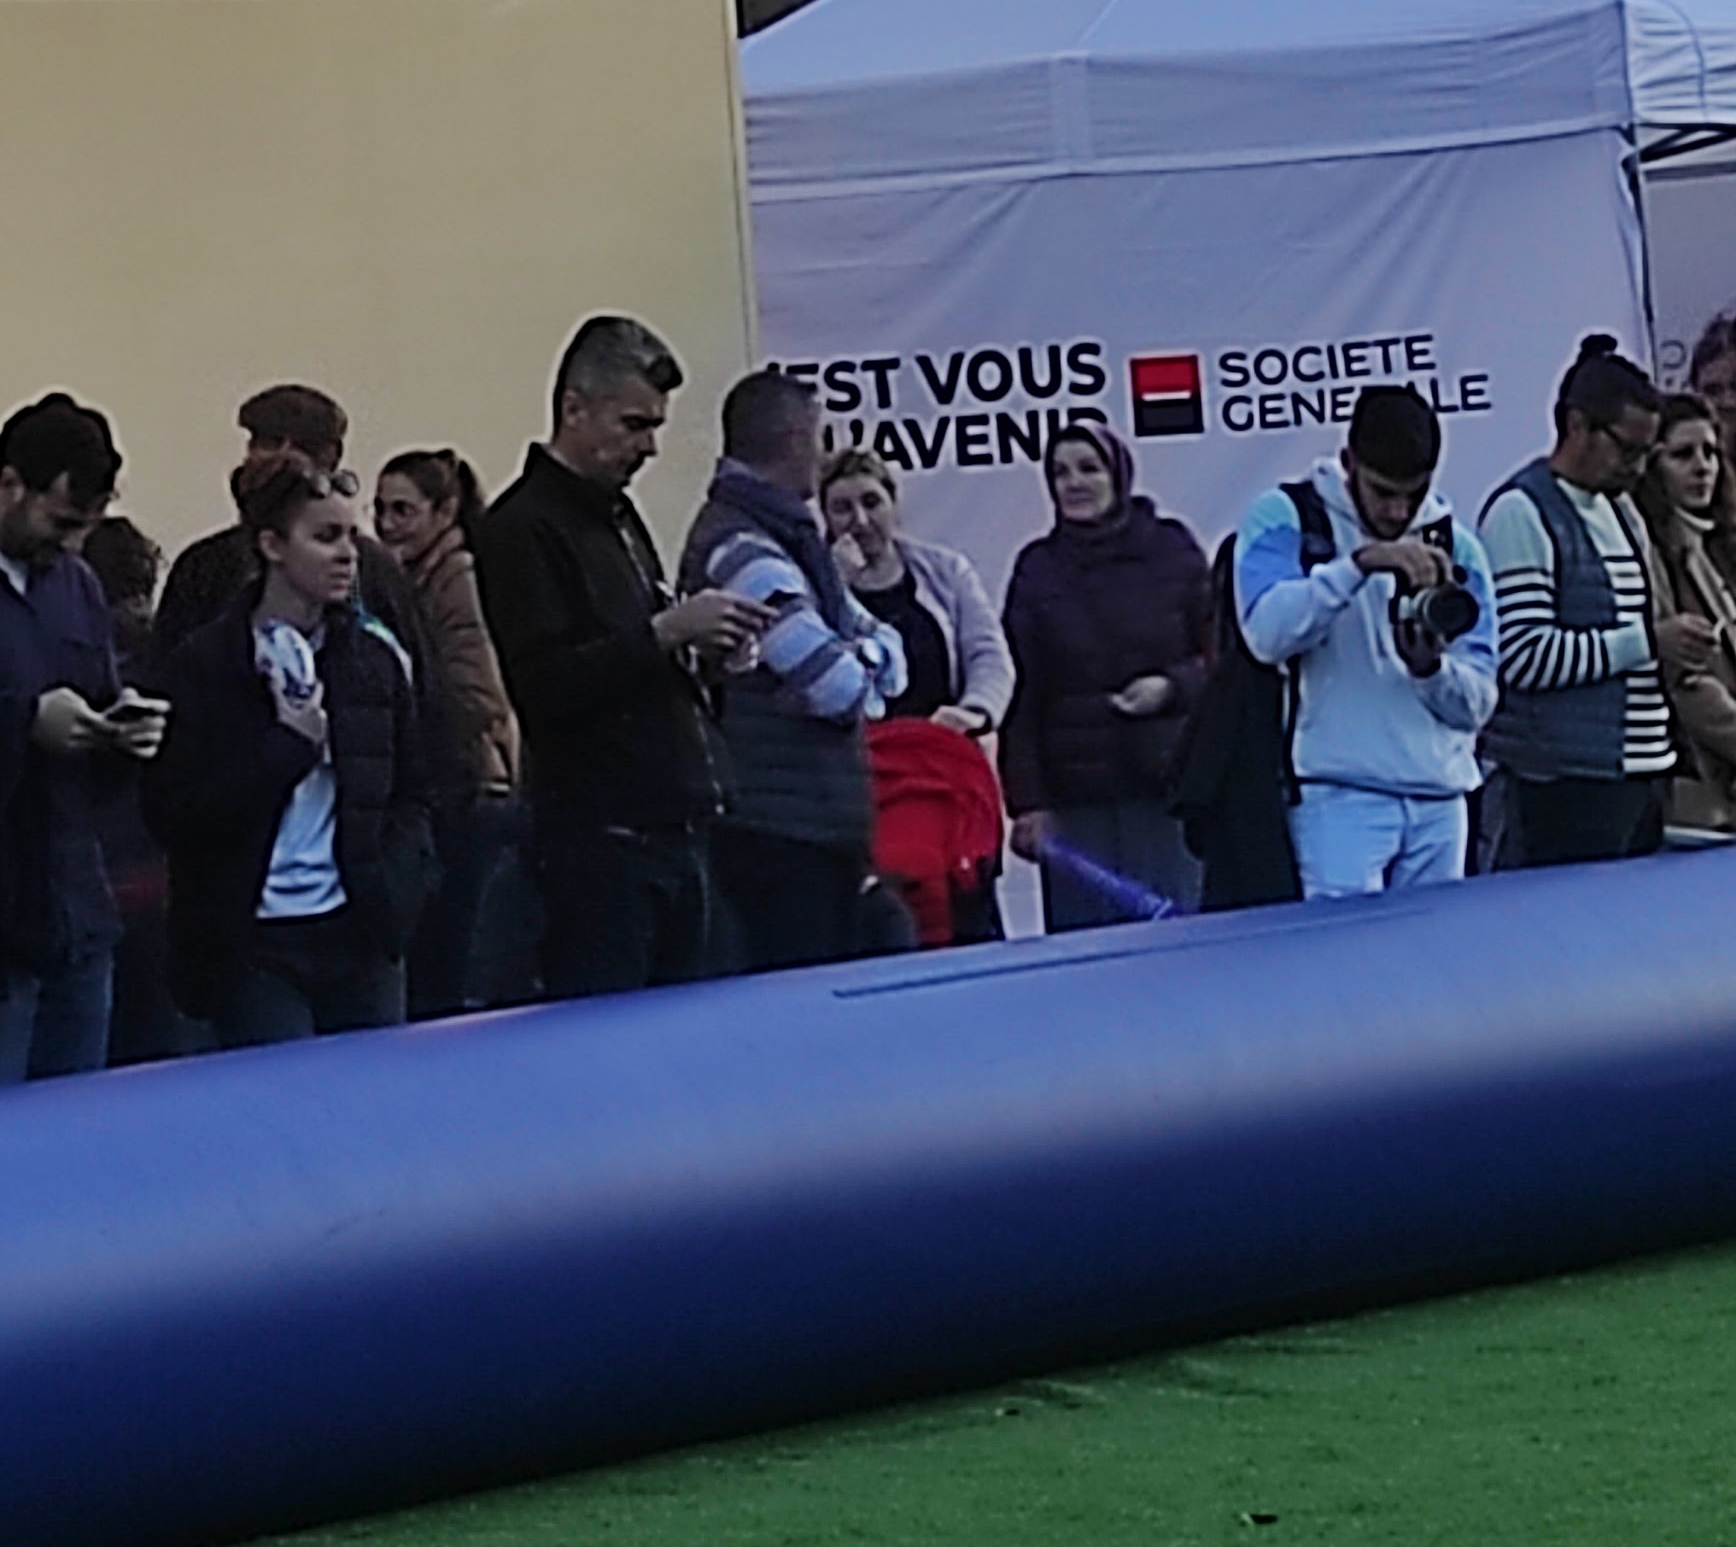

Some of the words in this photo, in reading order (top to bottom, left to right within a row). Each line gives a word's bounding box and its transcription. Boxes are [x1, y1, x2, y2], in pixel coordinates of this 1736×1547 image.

[915, 342, 1106, 405] VOUS
[1218, 333, 1437, 388] SOCIETE
[1221, 373, 1492, 432] GENELE
